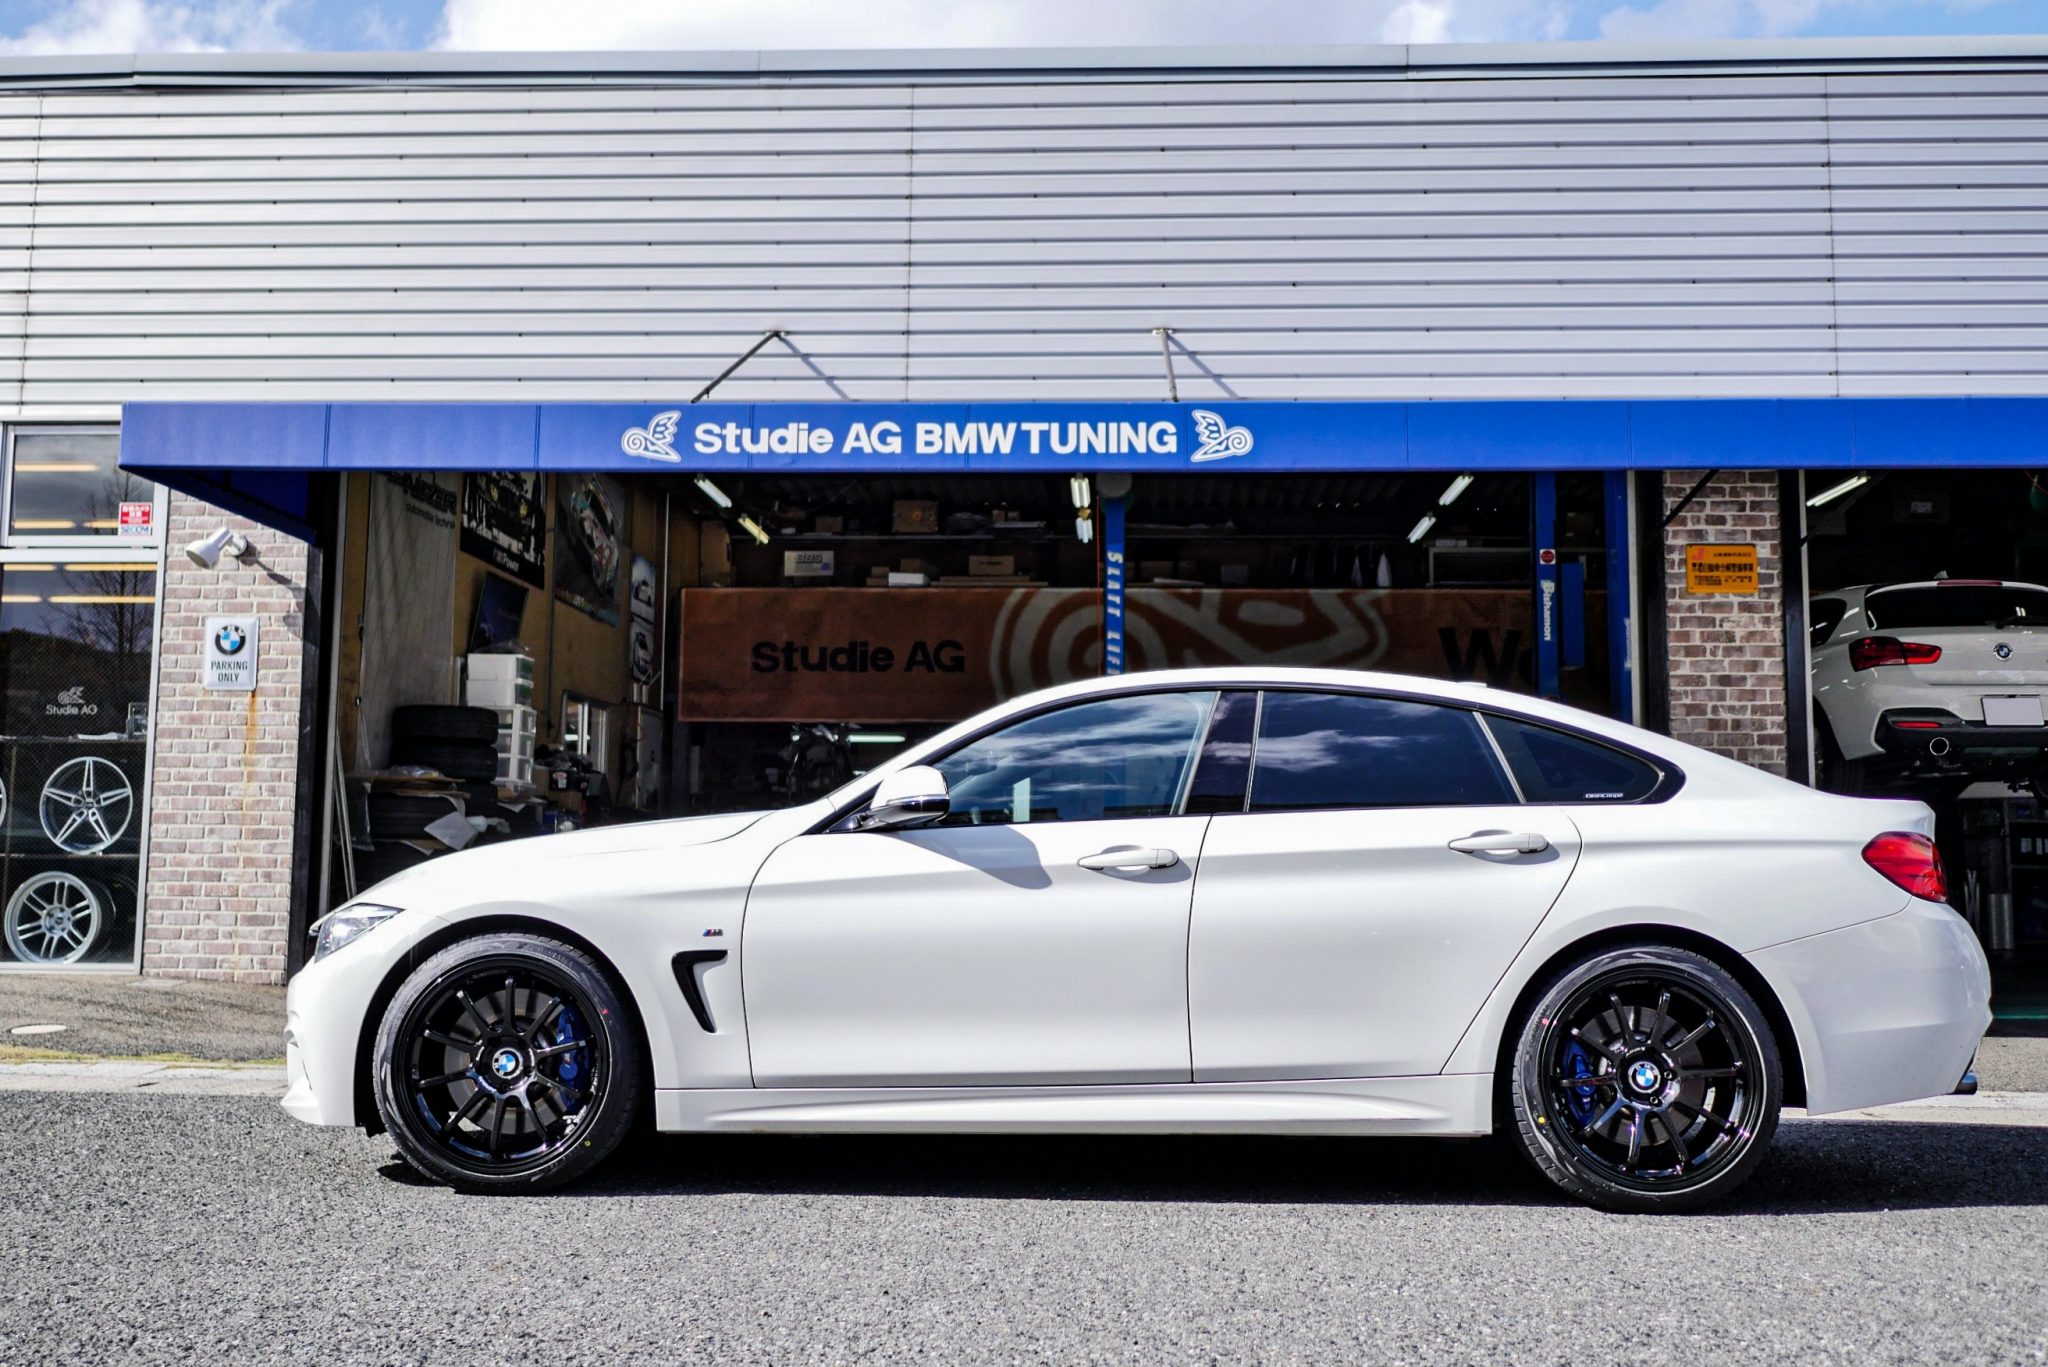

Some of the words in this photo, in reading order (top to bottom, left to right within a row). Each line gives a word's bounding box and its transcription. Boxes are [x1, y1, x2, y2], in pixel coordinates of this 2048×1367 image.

[694, 421, 834, 454] Studie
[842, 421, 902, 454] AG
[916, 421, 1016, 454] BMW
[1020, 421, 1177, 454] TUNING
[1540, 579, 1556, 641] Bishamon
[211, 660, 248, 671] PARKING
[752, 640, 895, 673] Studie
[904, 640, 965, 673] AG
[218, 672, 239, 683] ONLY
[45, 703, 79, 716] Studie
